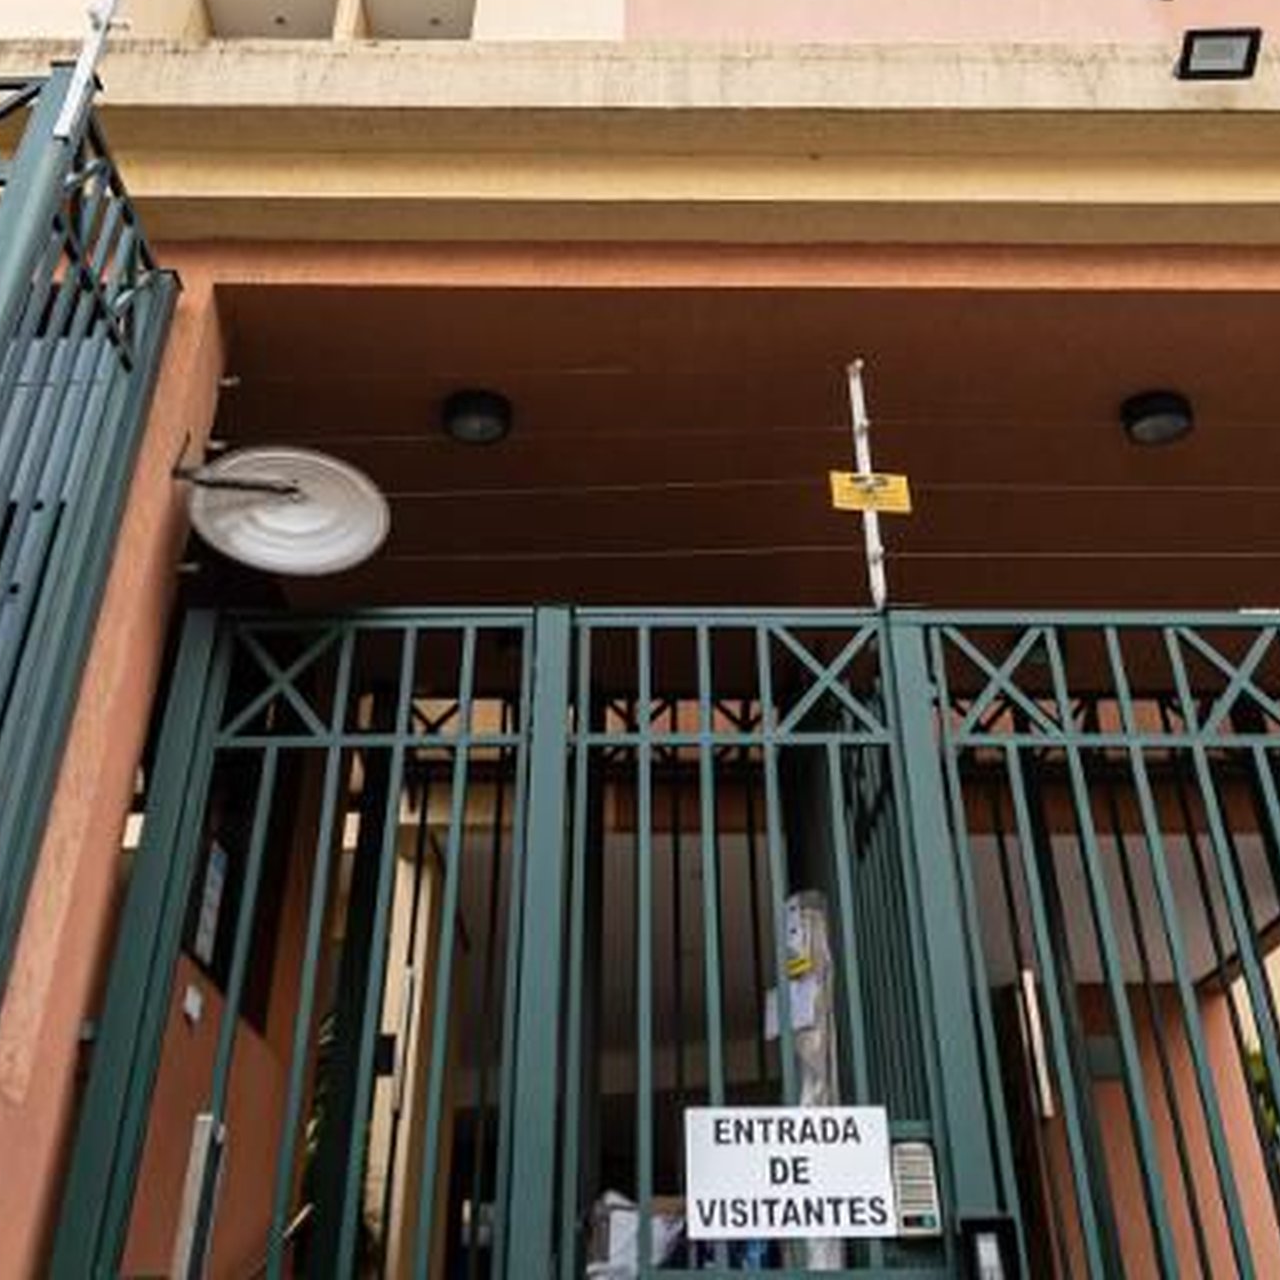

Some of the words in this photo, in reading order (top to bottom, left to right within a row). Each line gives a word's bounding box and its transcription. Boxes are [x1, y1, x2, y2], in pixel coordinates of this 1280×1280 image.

[713, 1117, 861, 1145] ENTRADA
[769, 1156, 811, 1185] DE
[696, 1197, 888, 1227] VISITANTES
